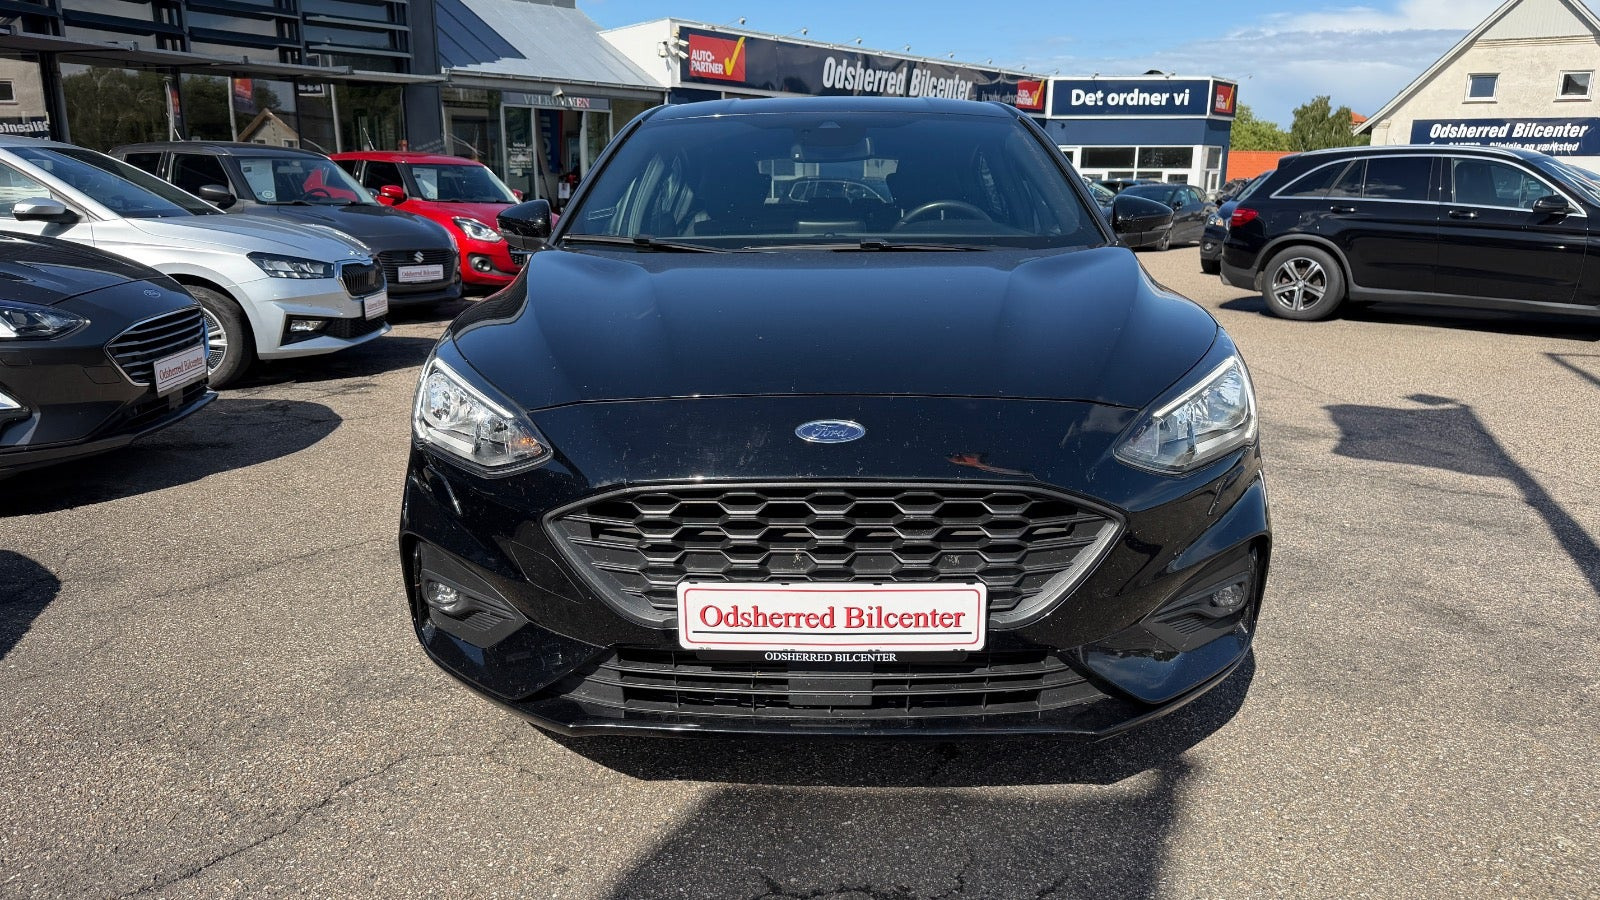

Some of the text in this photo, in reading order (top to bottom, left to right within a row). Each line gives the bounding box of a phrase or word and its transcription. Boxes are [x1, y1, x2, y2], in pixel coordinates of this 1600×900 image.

[691, 60, 724, 75] PARTNER
[822, 56, 973, 100] Odsherred Bilcenter
[523, 94, 590, 108] VELKOMMEN
[1071, 88, 1190, 106] Det ordner vi
[1430, 123, 1588, 138] Odsherred Bilcenter
[700, 605, 965, 629] Odsherred Bilcenter
[764, 652, 897, 662] ODSHERRED BILCENTER
